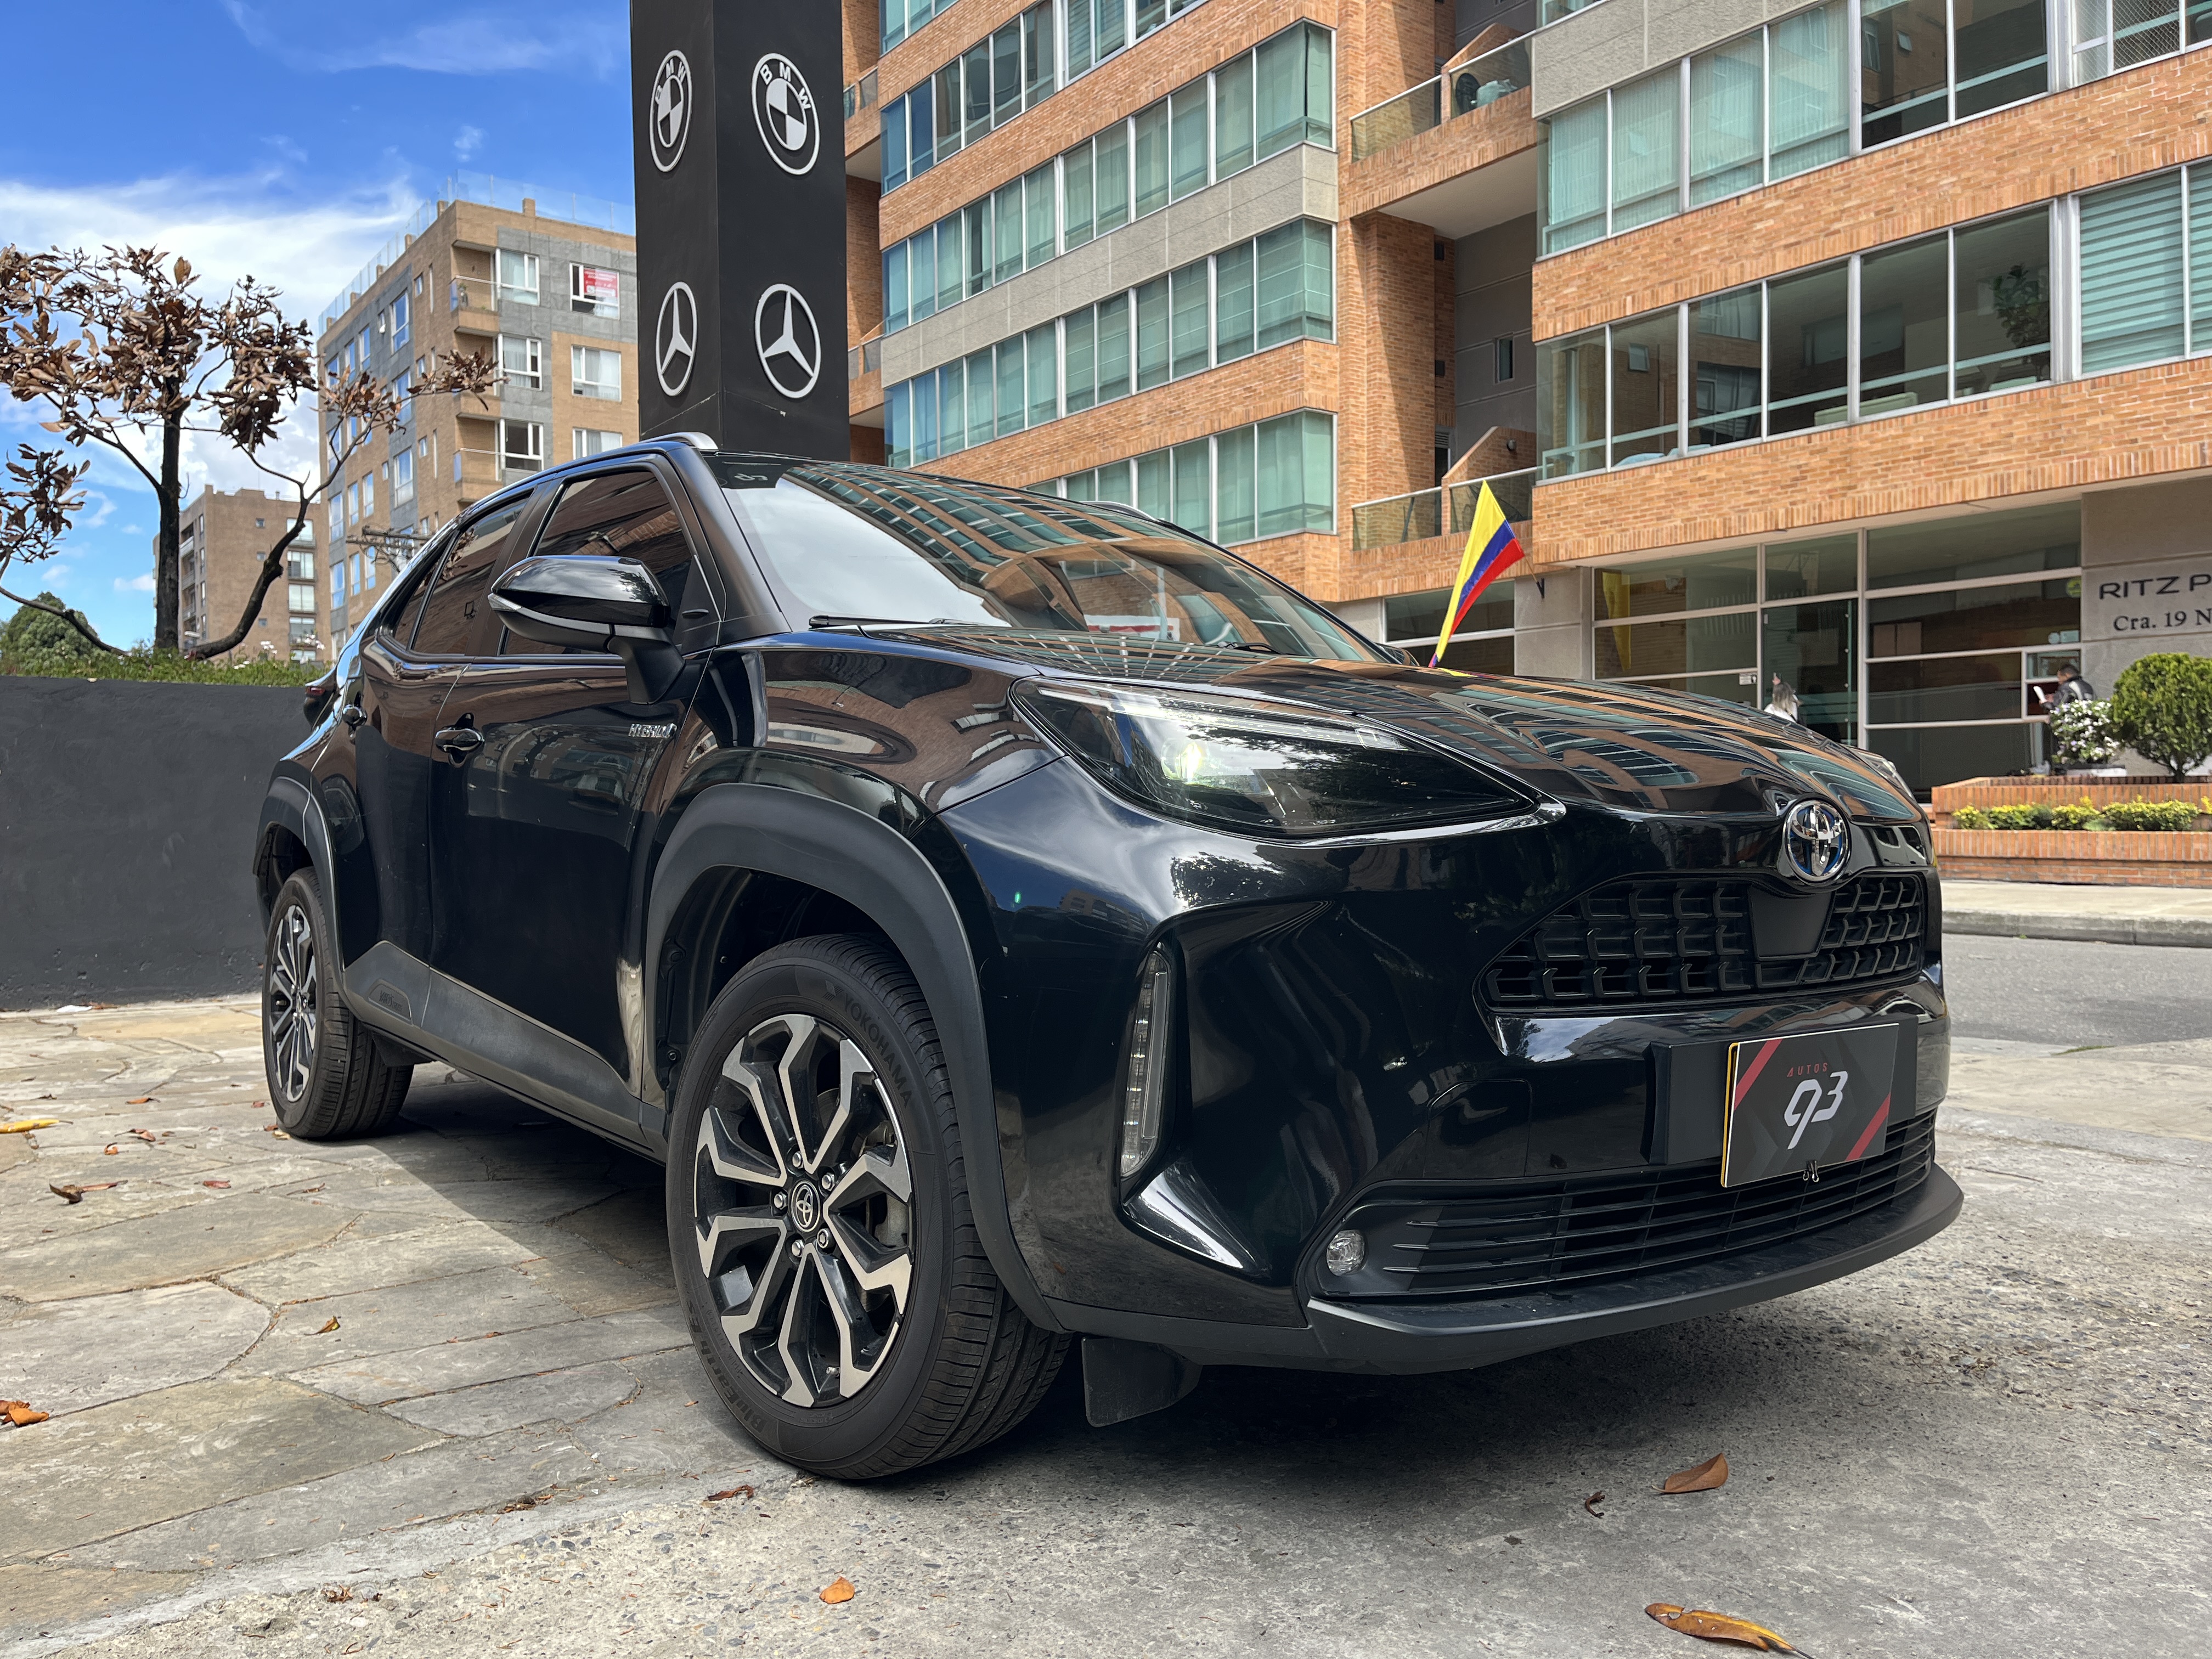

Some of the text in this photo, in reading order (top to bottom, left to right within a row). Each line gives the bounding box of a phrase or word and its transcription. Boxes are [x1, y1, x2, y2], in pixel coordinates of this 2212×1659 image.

[654, 58, 686, 105] BMW
[759, 61, 812, 110] BMW
[2099, 576, 2180, 600] RITZ
[2113, 615, 2157, 631] Cra.
[2164, 611, 2187, 627] 19
[628, 723, 667, 738] HYBRID
[842, 990, 913, 1108] YOKOHAMA
[1786, 1062, 1829, 1077] AUTOS
